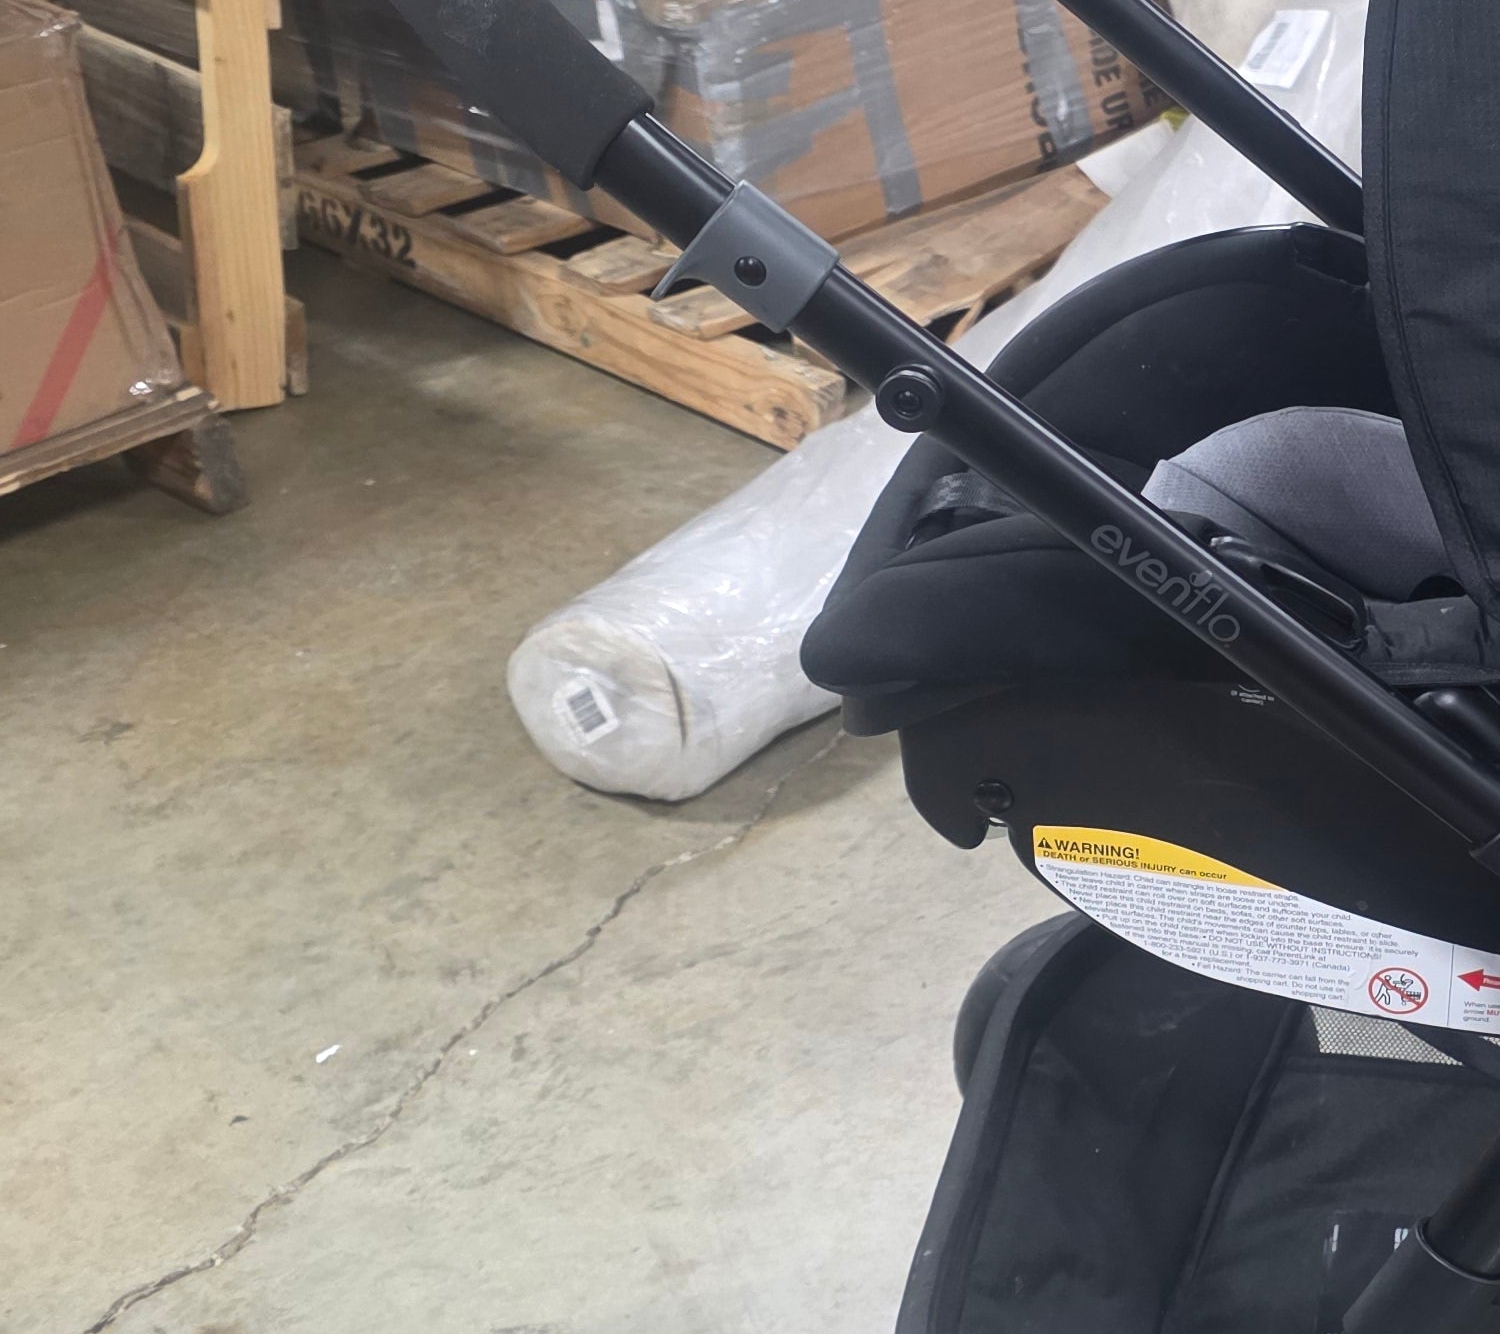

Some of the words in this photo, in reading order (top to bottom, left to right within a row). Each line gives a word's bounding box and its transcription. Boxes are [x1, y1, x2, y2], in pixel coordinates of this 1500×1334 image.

[1090, 524, 1241, 643] evenflo
[1054, 838, 1140, 860] WARNING!
[1043, 850, 1077, 861] DEATH
[1092, 856, 1138, 869] SERIOUS
[1140, 862, 1177, 873] INJURY
[1179, 868, 1197, 876] can
[1199, 872, 1227, 880] occur
[1266, 942, 1309, 952] WITHOUT
